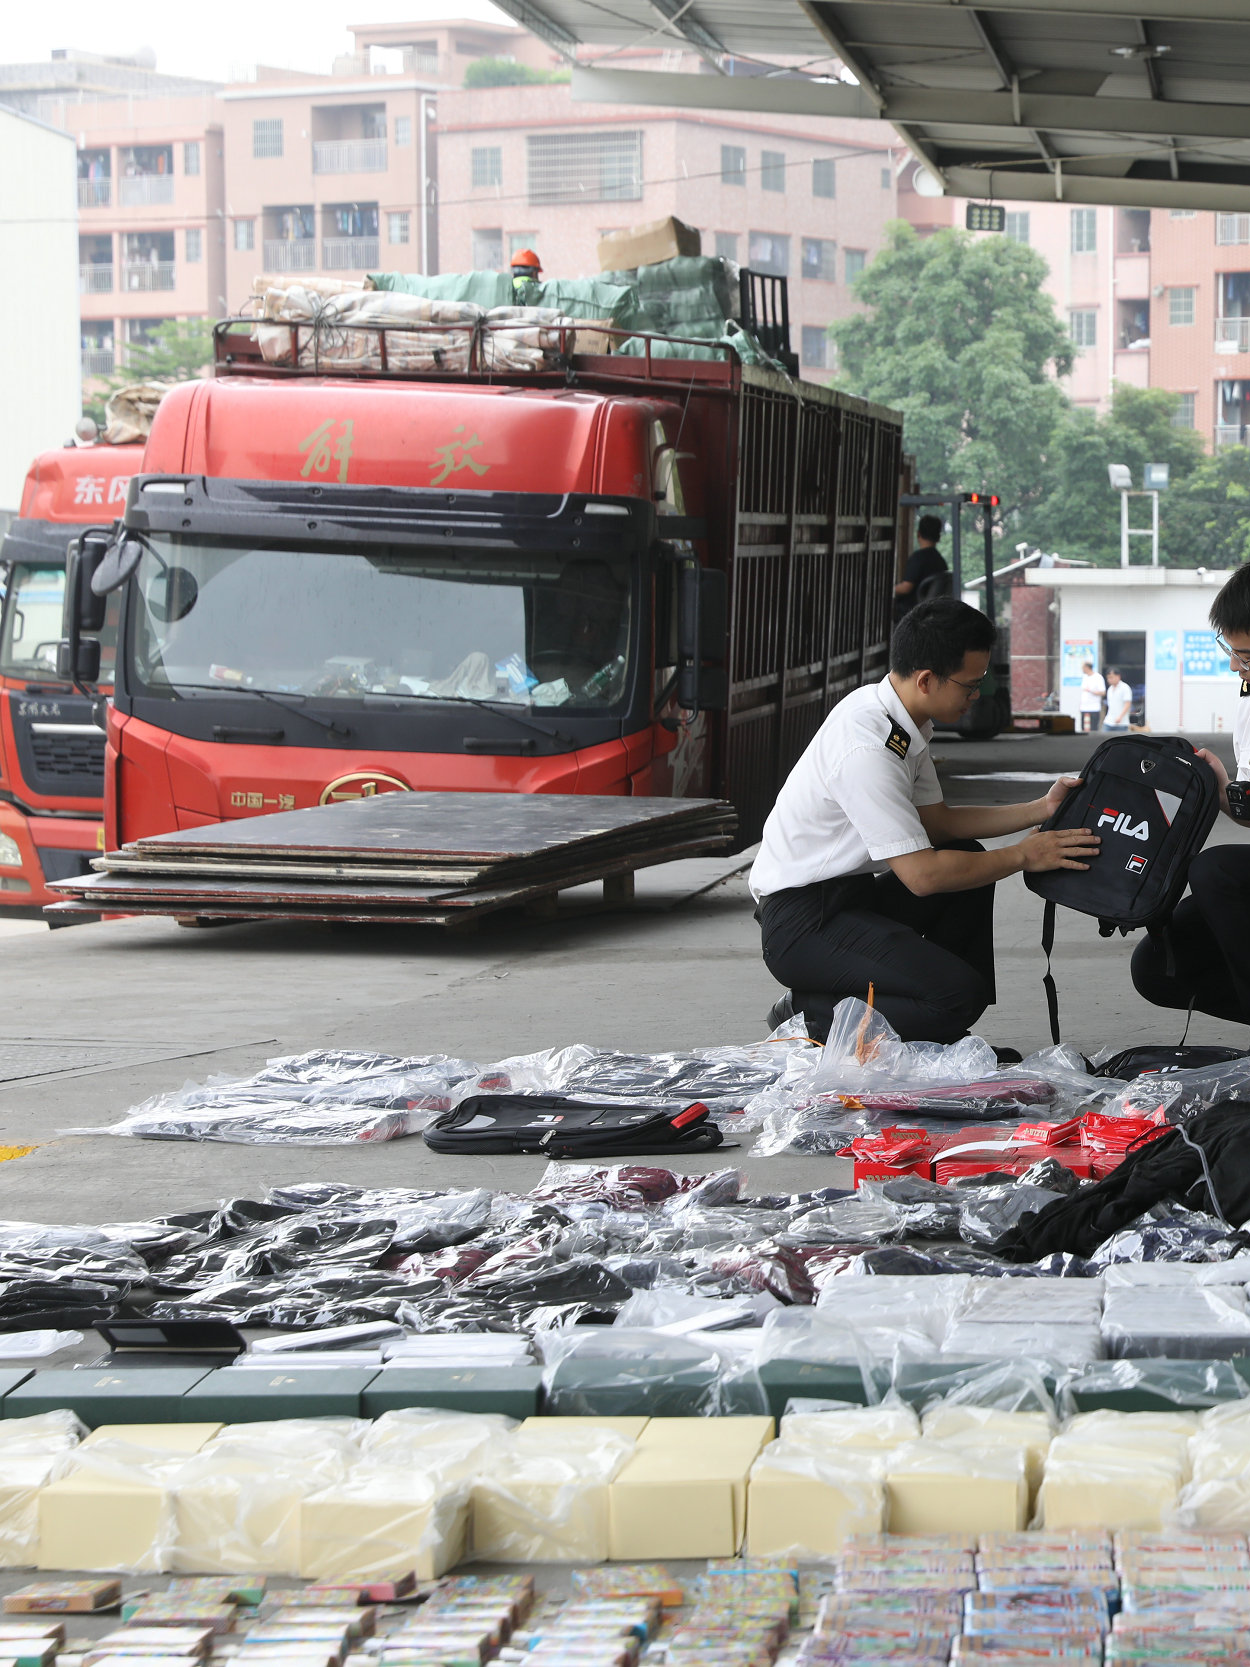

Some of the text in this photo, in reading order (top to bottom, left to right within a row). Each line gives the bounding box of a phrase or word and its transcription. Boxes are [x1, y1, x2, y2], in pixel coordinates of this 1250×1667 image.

[231, 791, 295, 810] 中国一汽
[1097, 807, 1149, 842] FILA
